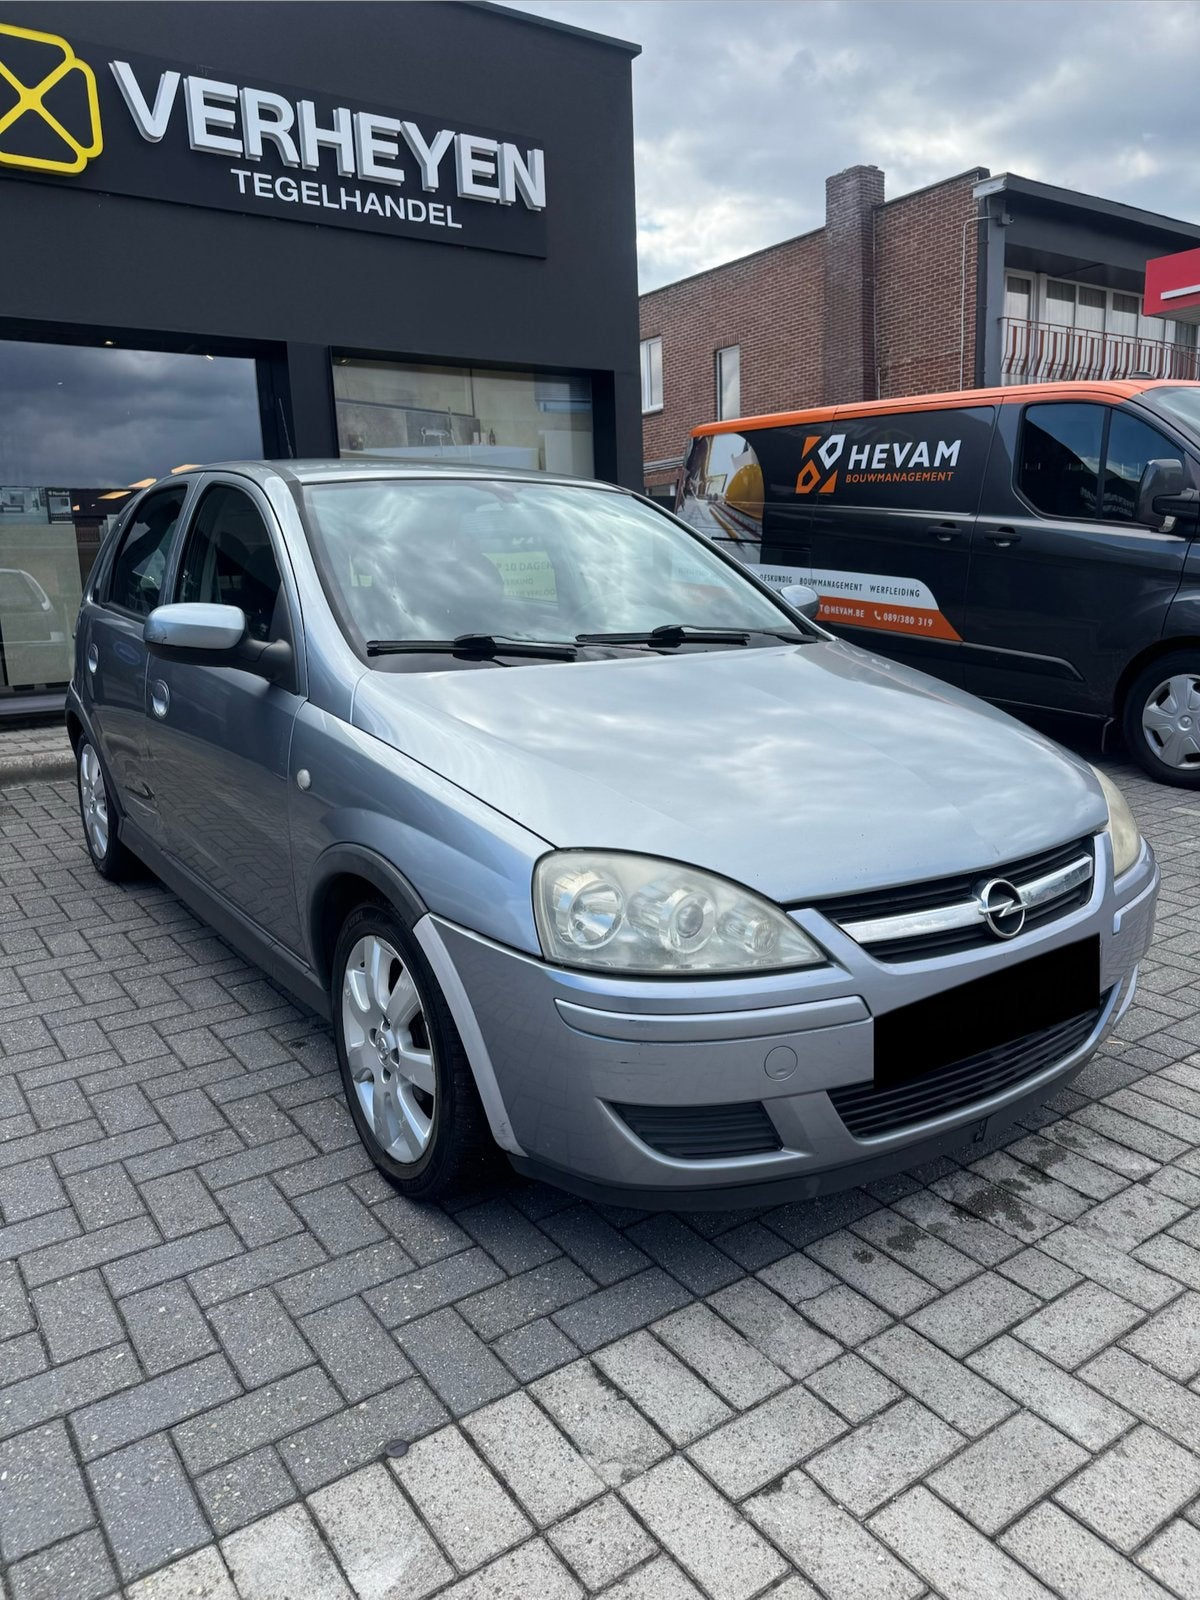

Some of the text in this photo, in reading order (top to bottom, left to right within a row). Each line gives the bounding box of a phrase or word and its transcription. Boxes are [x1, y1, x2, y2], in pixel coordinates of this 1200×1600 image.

[108, 60, 546, 211] VERHEYEN
[230, 168, 463, 229] TEGELHANDEL
[848, 440, 962, 470] HEVAM
[845, 471, 955, 484] BOUWMANAGEMENT
[799, 577, 863, 592] BOUWMANAGEMENT
[869, 585, 921, 598] WERFLEIDING
[883, 613, 915, 625] 089/380
[917, 617, 934, 627] 319
